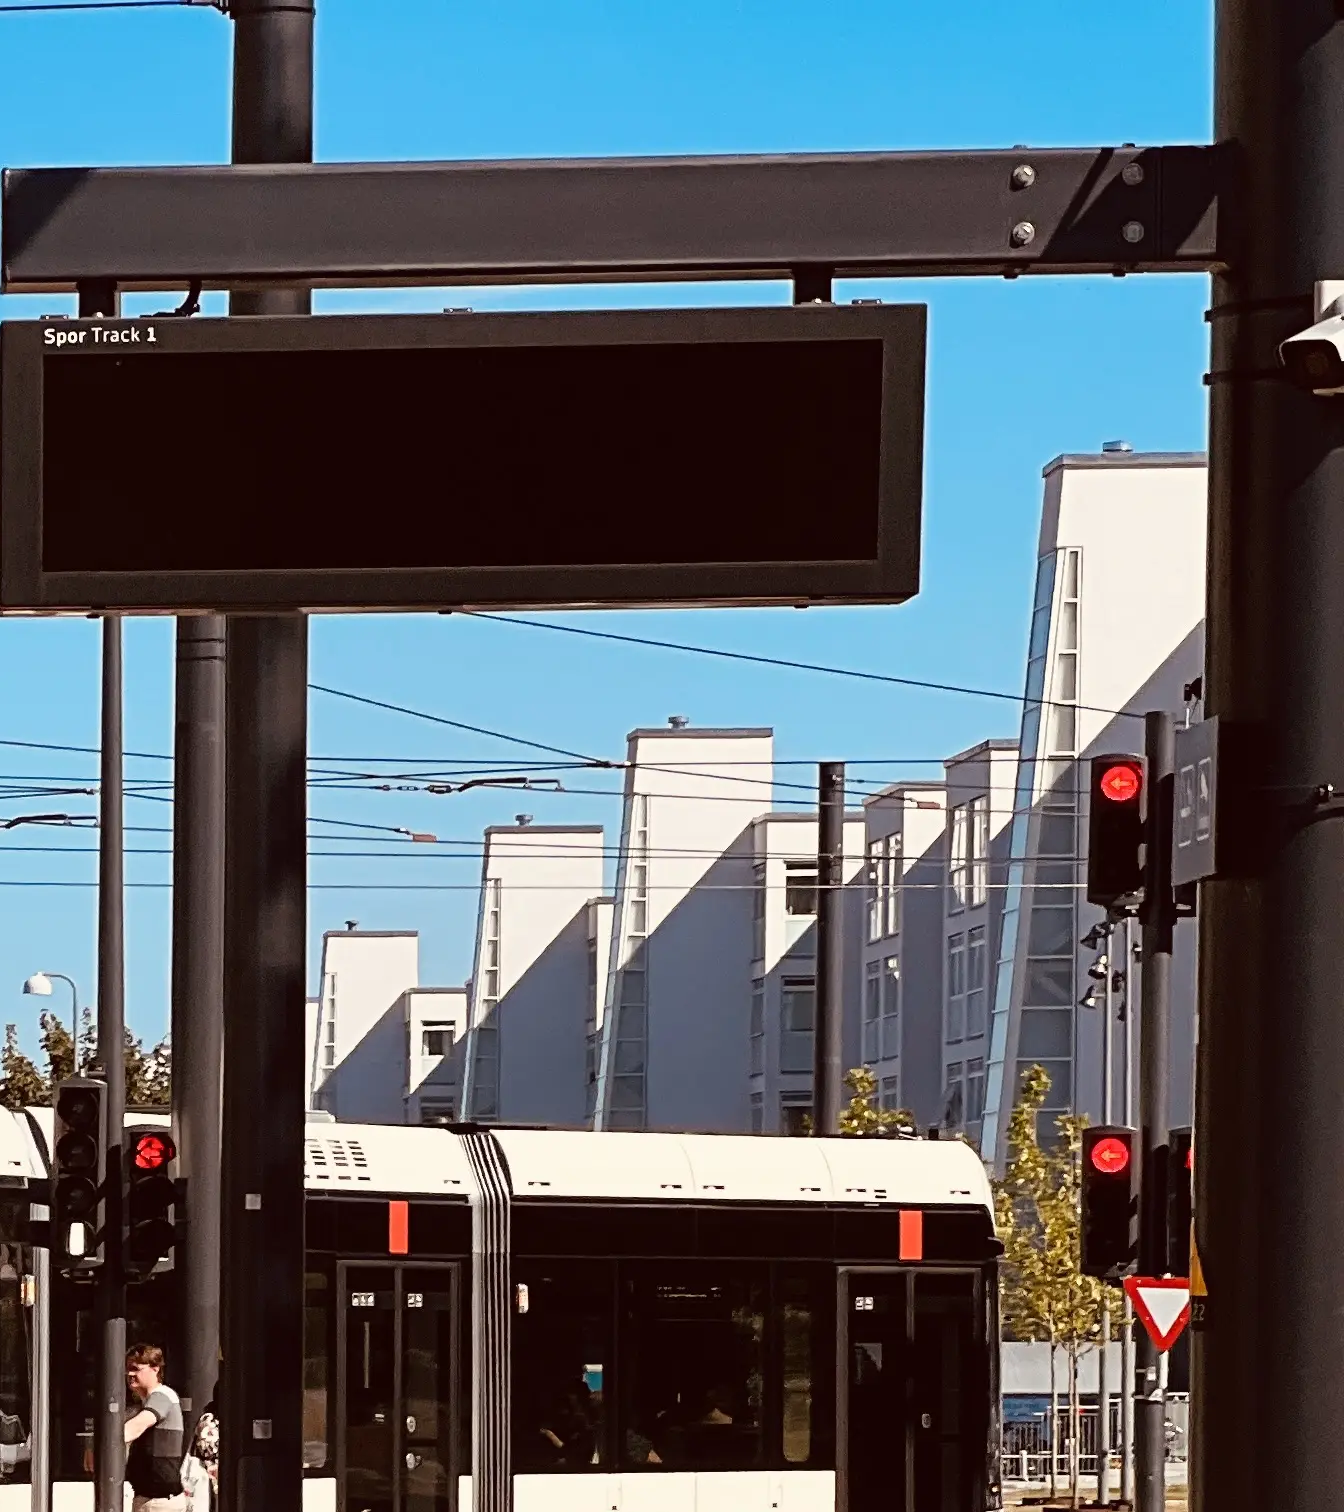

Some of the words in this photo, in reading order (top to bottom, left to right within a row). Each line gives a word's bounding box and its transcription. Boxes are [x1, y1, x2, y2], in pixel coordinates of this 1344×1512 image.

[44, 327, 87, 347] Spor
[92, 326, 140, 343] Track
[146, 326, 157, 342] 1
